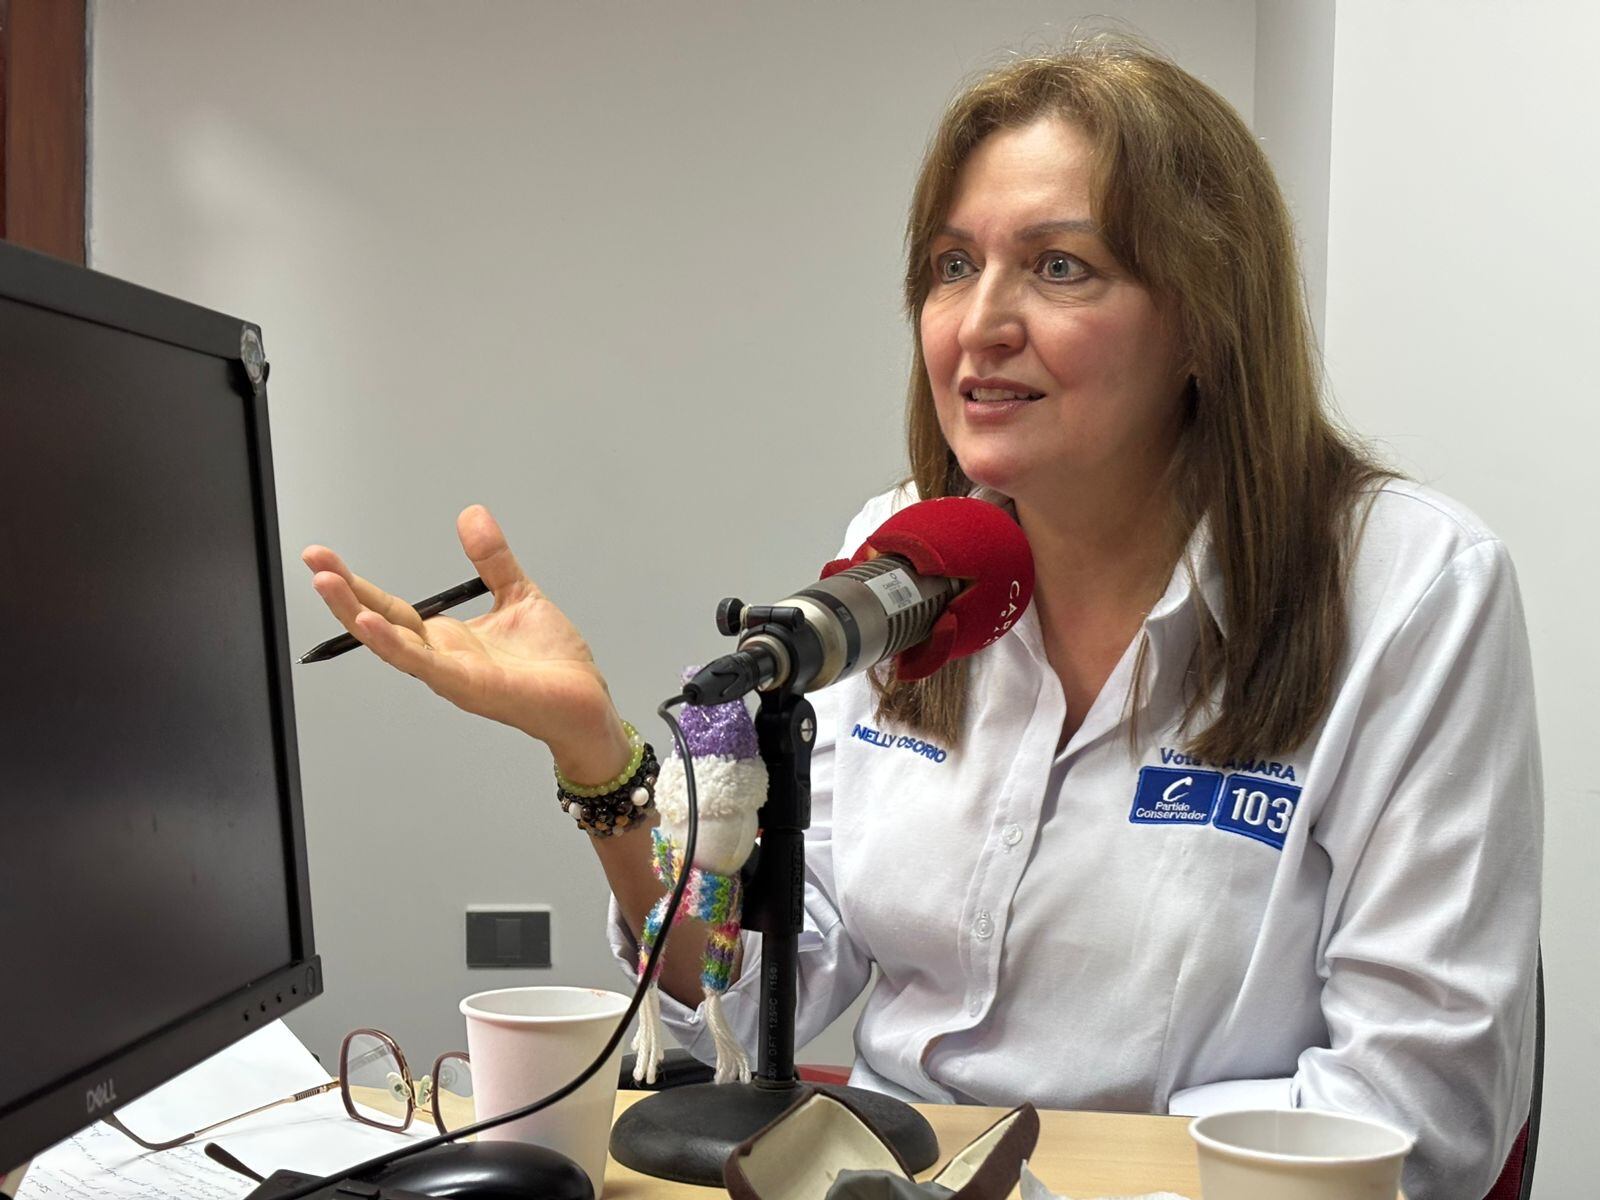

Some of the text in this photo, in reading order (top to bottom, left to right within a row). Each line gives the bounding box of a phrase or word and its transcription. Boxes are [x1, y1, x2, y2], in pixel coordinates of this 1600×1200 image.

[851, 723, 947, 763] NELLY OSORIO
[1209, 758, 1296, 782] AMARA
[1136, 807, 1207, 821] Conservador
[1155, 801, 1190, 812] Partido
[1232, 788, 1293, 834] 103
[86, 1078, 117, 1114] DELL
